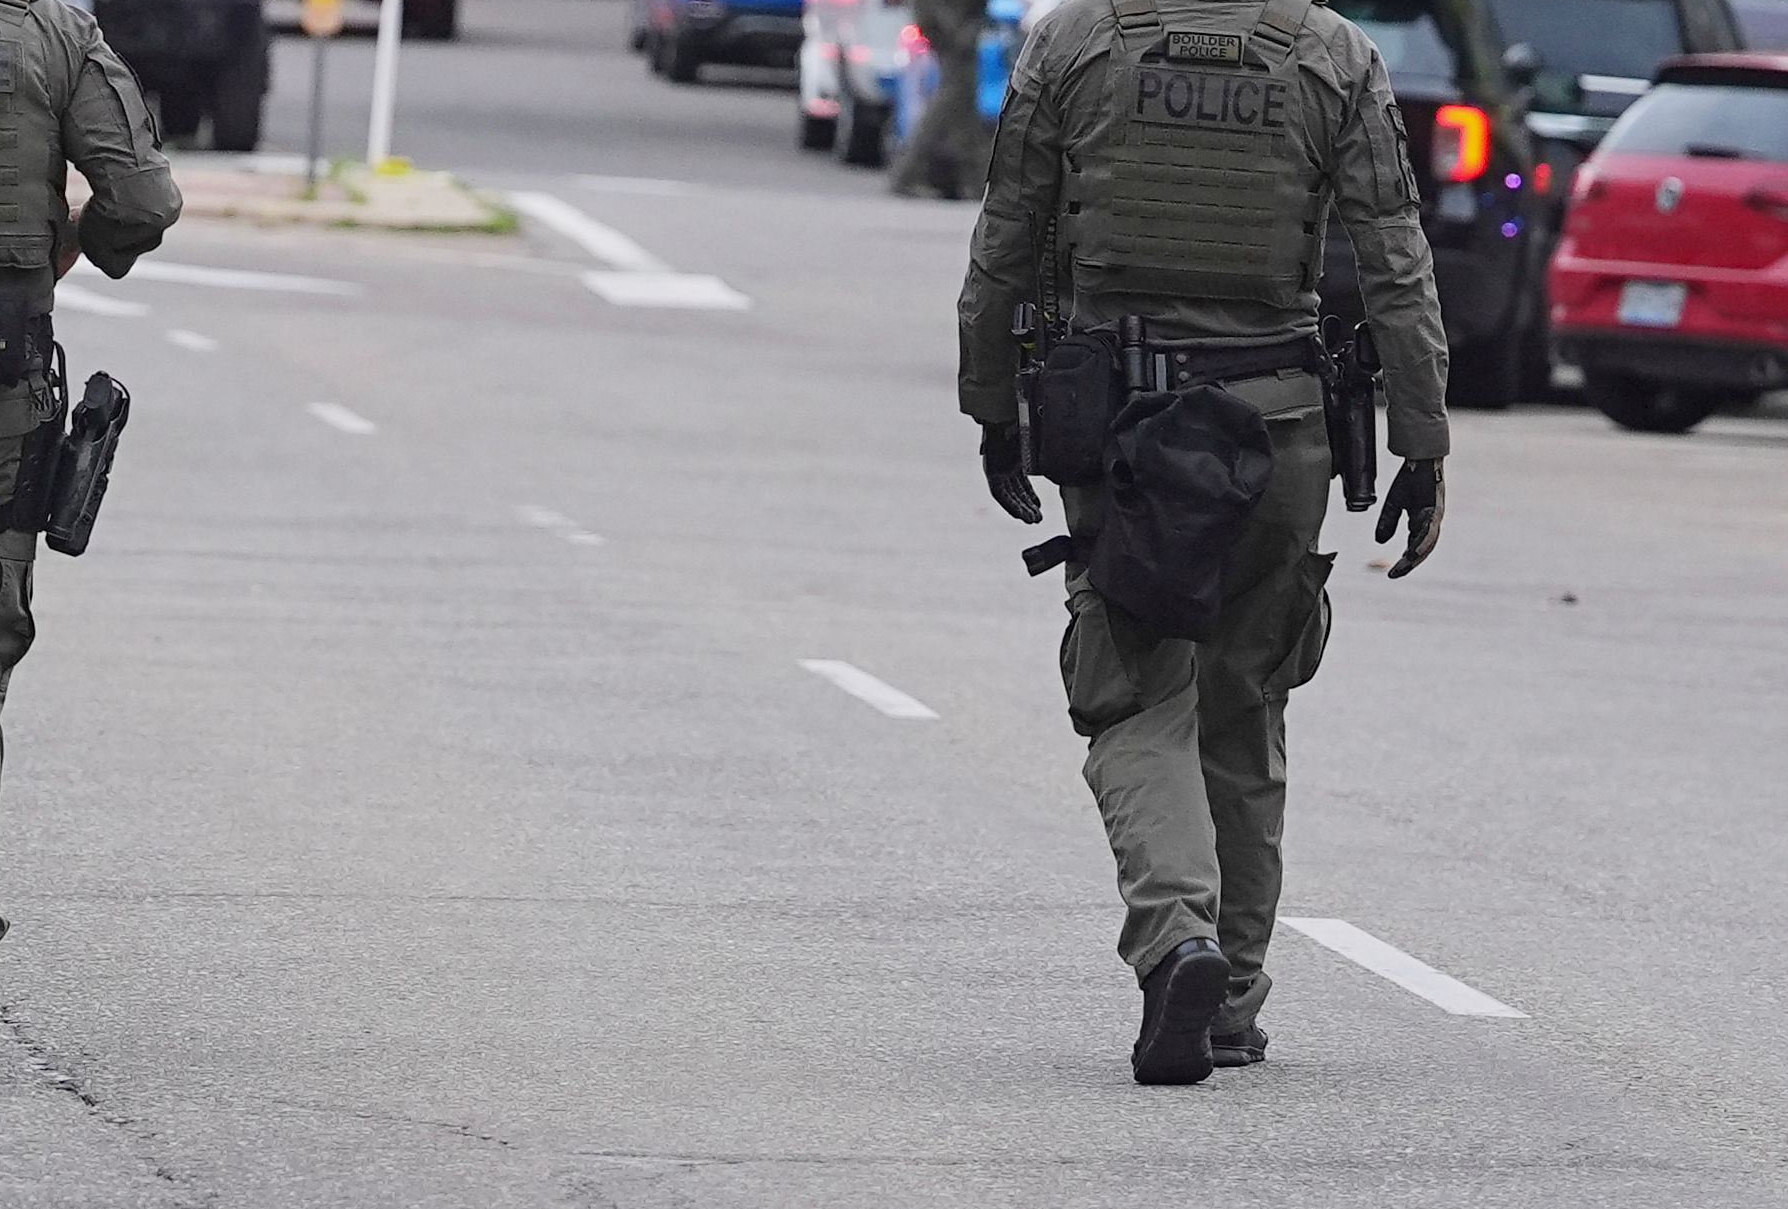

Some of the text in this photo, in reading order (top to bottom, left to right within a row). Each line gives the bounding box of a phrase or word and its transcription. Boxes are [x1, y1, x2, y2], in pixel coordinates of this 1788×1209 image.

[1172, 34, 1235, 47] BOULDER
[1180, 46, 1228, 58] POLICE
[1136, 70, 1287, 129] POLICE
